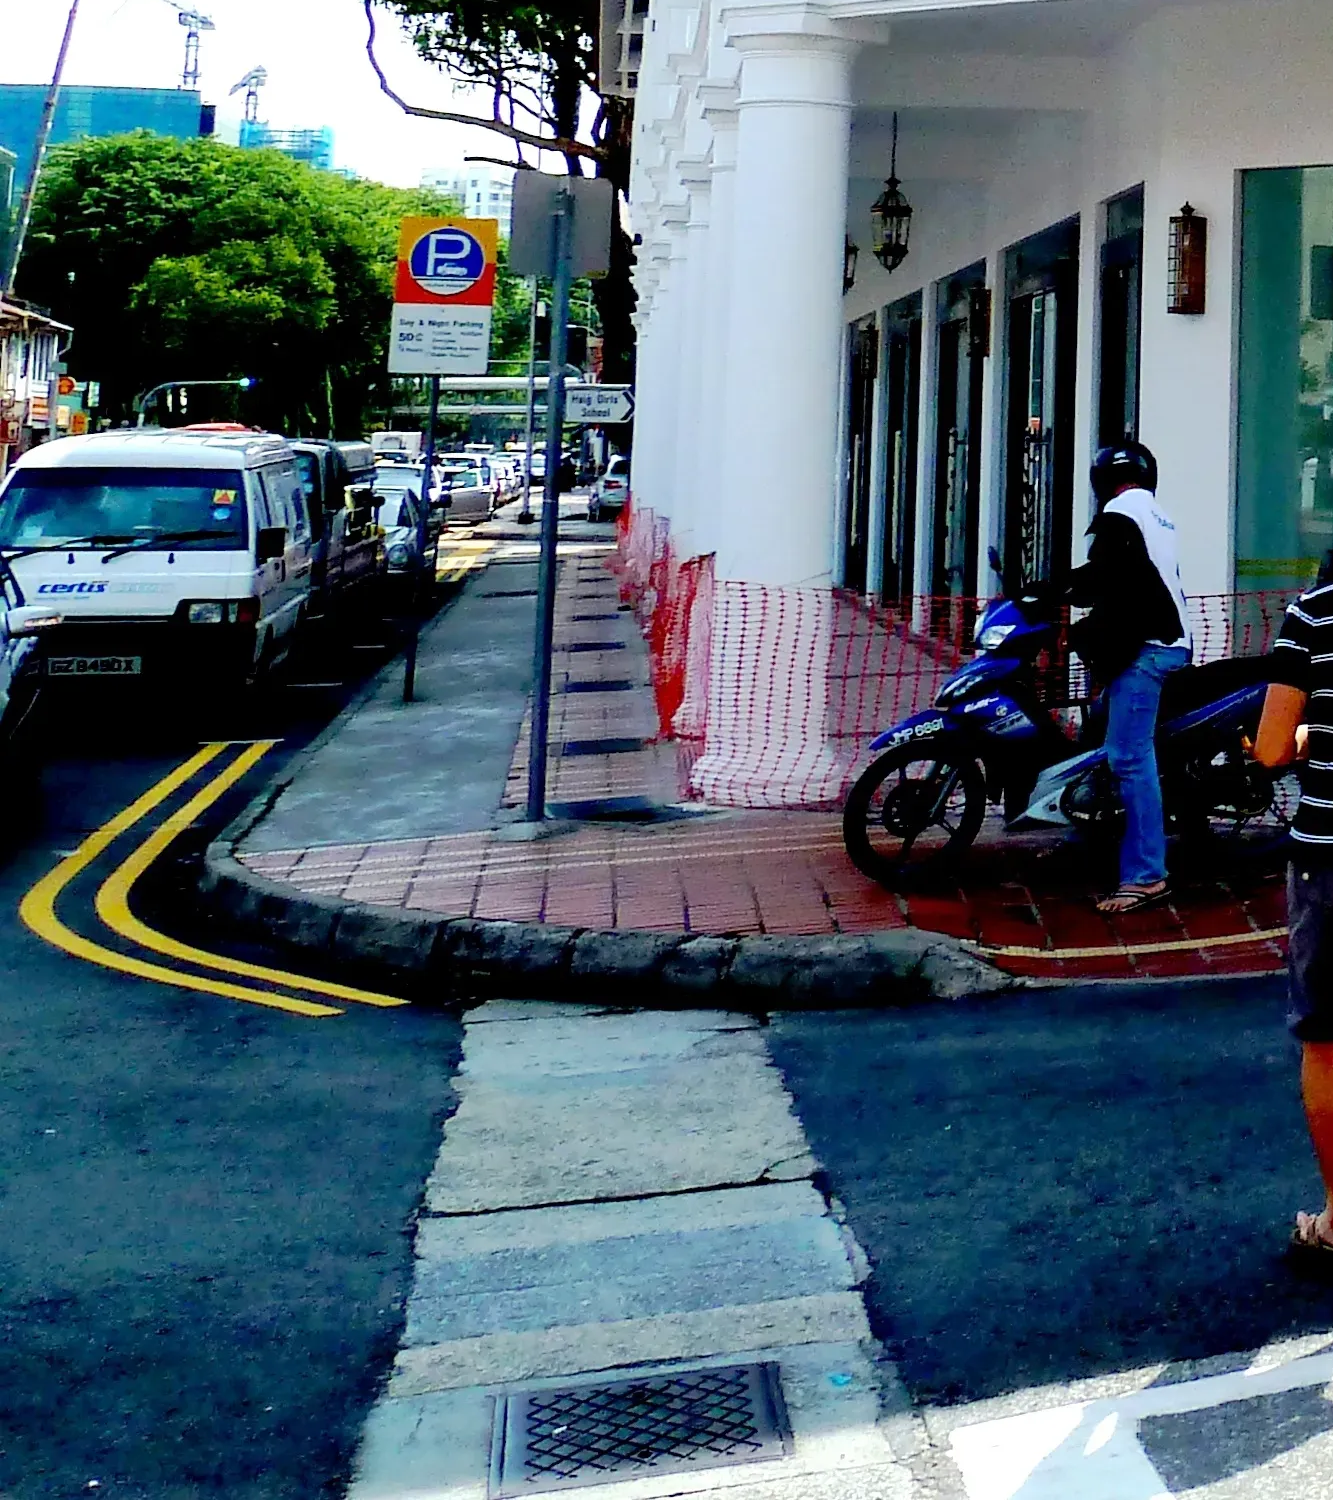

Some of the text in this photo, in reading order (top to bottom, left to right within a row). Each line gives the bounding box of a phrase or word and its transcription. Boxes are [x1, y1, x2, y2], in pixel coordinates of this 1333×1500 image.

[426, 233, 471, 276] P
[581, 408, 611, 417] School
[38, 581, 109, 594] certis
